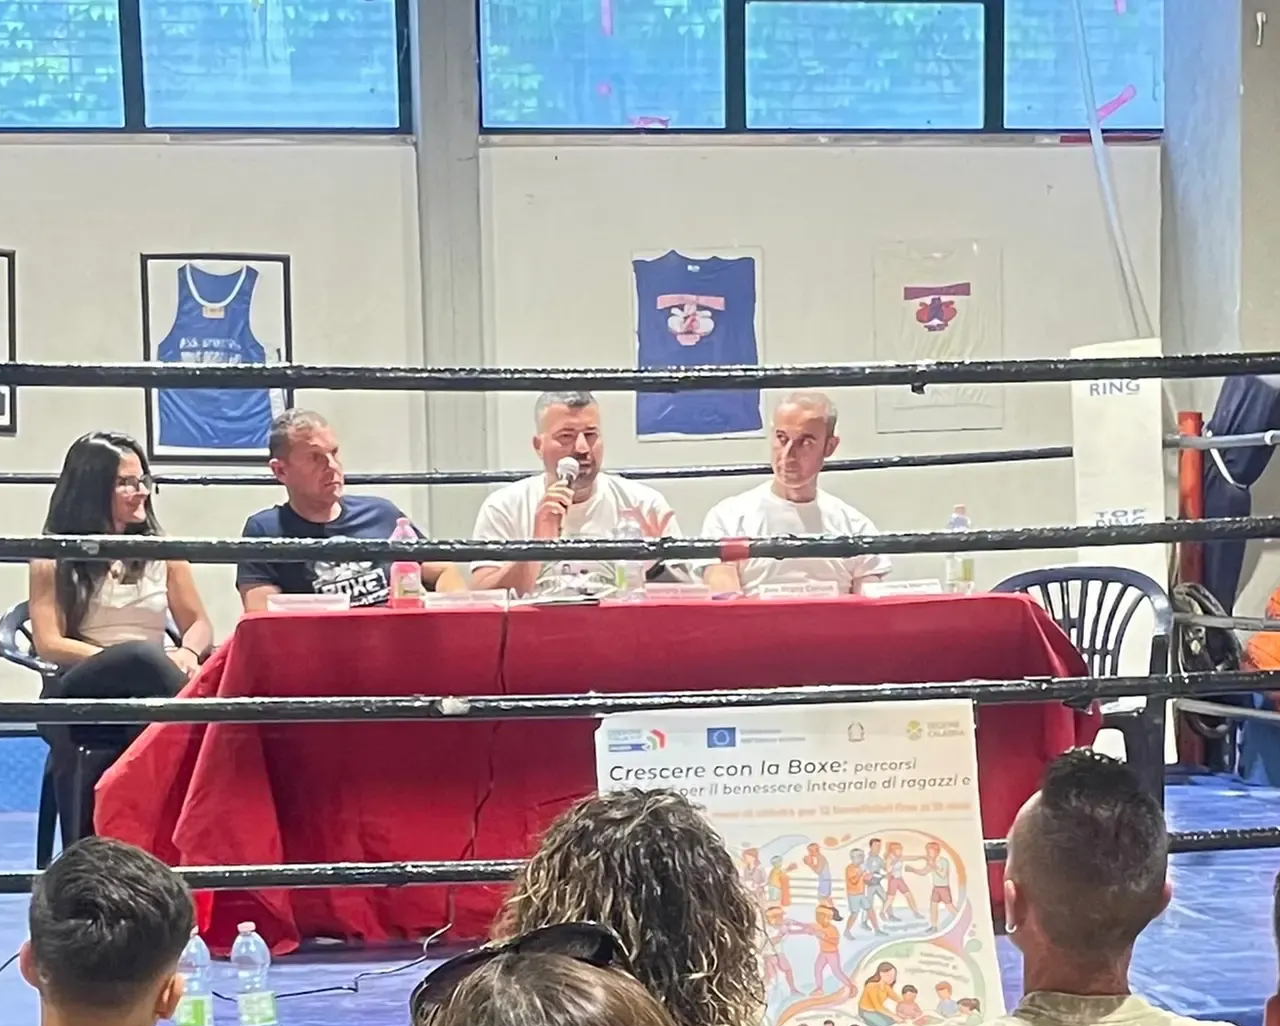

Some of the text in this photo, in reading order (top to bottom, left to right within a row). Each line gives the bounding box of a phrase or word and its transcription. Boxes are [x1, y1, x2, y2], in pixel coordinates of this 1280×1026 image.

[1089, 381, 1140, 396] RING
[609, 757, 917, 782] Crescere con la Boxe: percorsi
[679, 786, 704, 798] per
[708, 782, 719, 796] il
[723, 782, 803, 796] benessere
[807, 777, 877, 794] integrale
[882, 775, 896, 790] di
[900, 774, 958, 792] ragazzi
[962, 776, 972, 785] e
